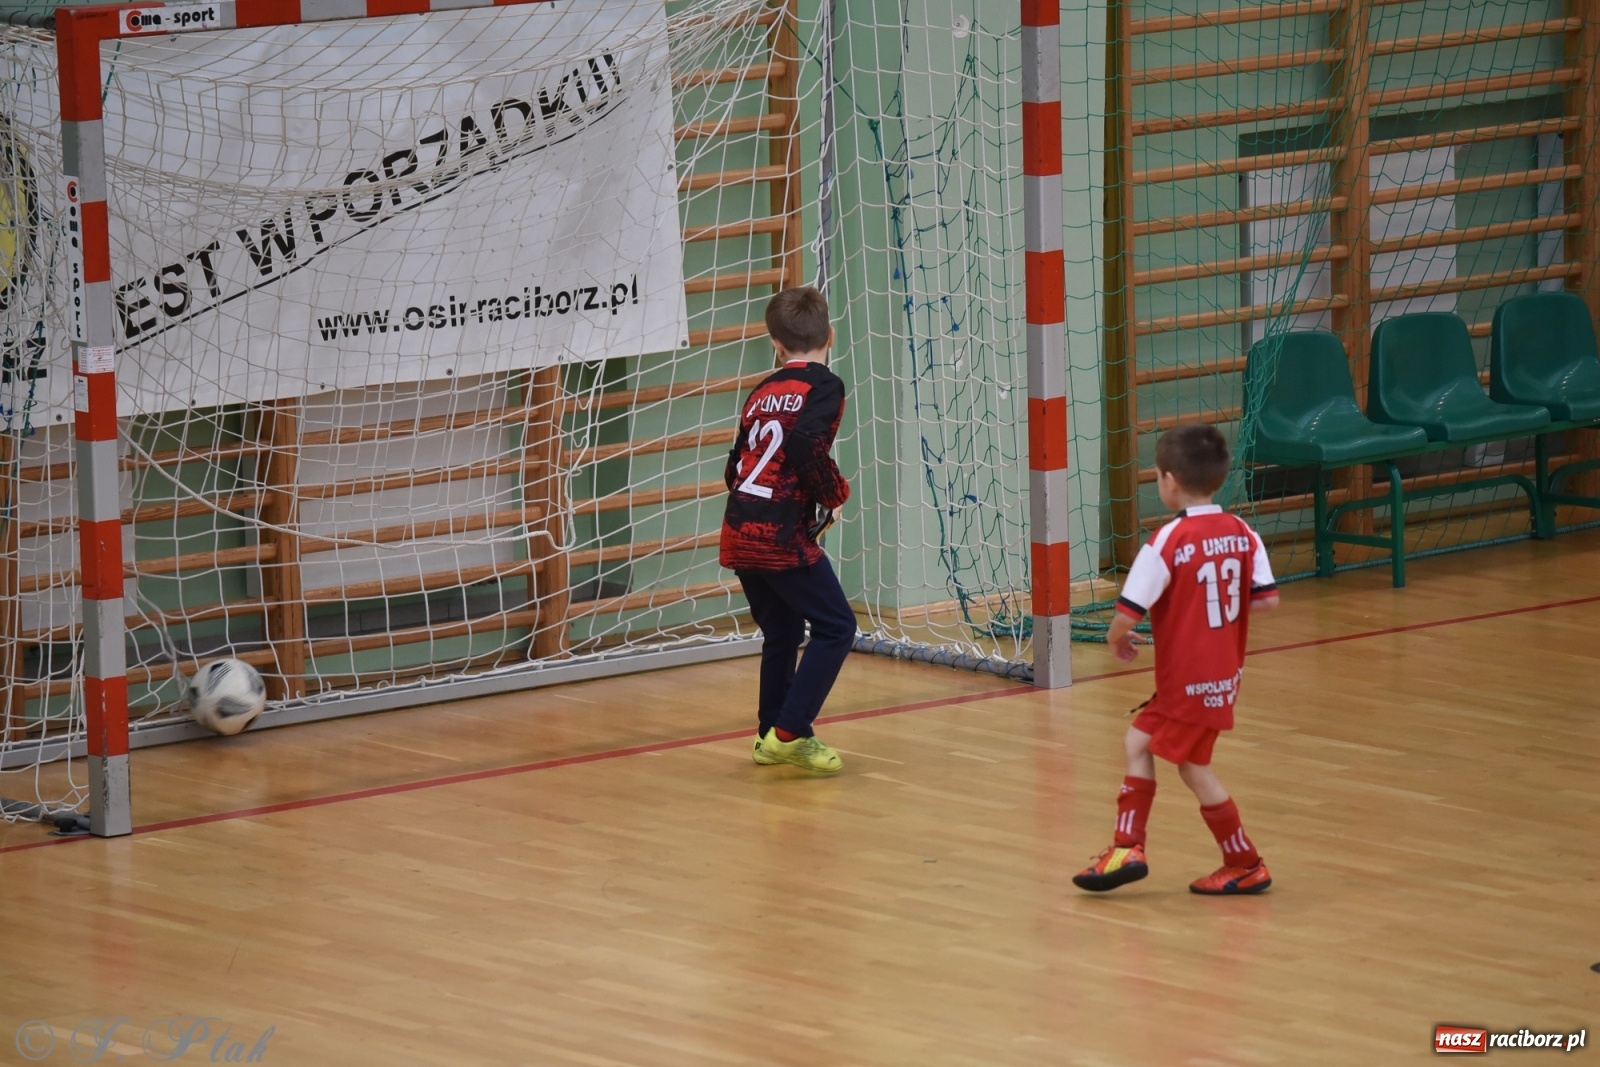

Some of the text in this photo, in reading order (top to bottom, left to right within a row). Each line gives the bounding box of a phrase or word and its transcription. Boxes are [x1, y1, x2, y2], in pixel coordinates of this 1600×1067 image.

[173, 7, 215, 27] sport
[114, 240, 221, 339] EST
[317, 273, 639, 342] www.osir-raciborz.pl
[1174, 543, 1196, 567] AP
[1196, 557, 1242, 629] 13
